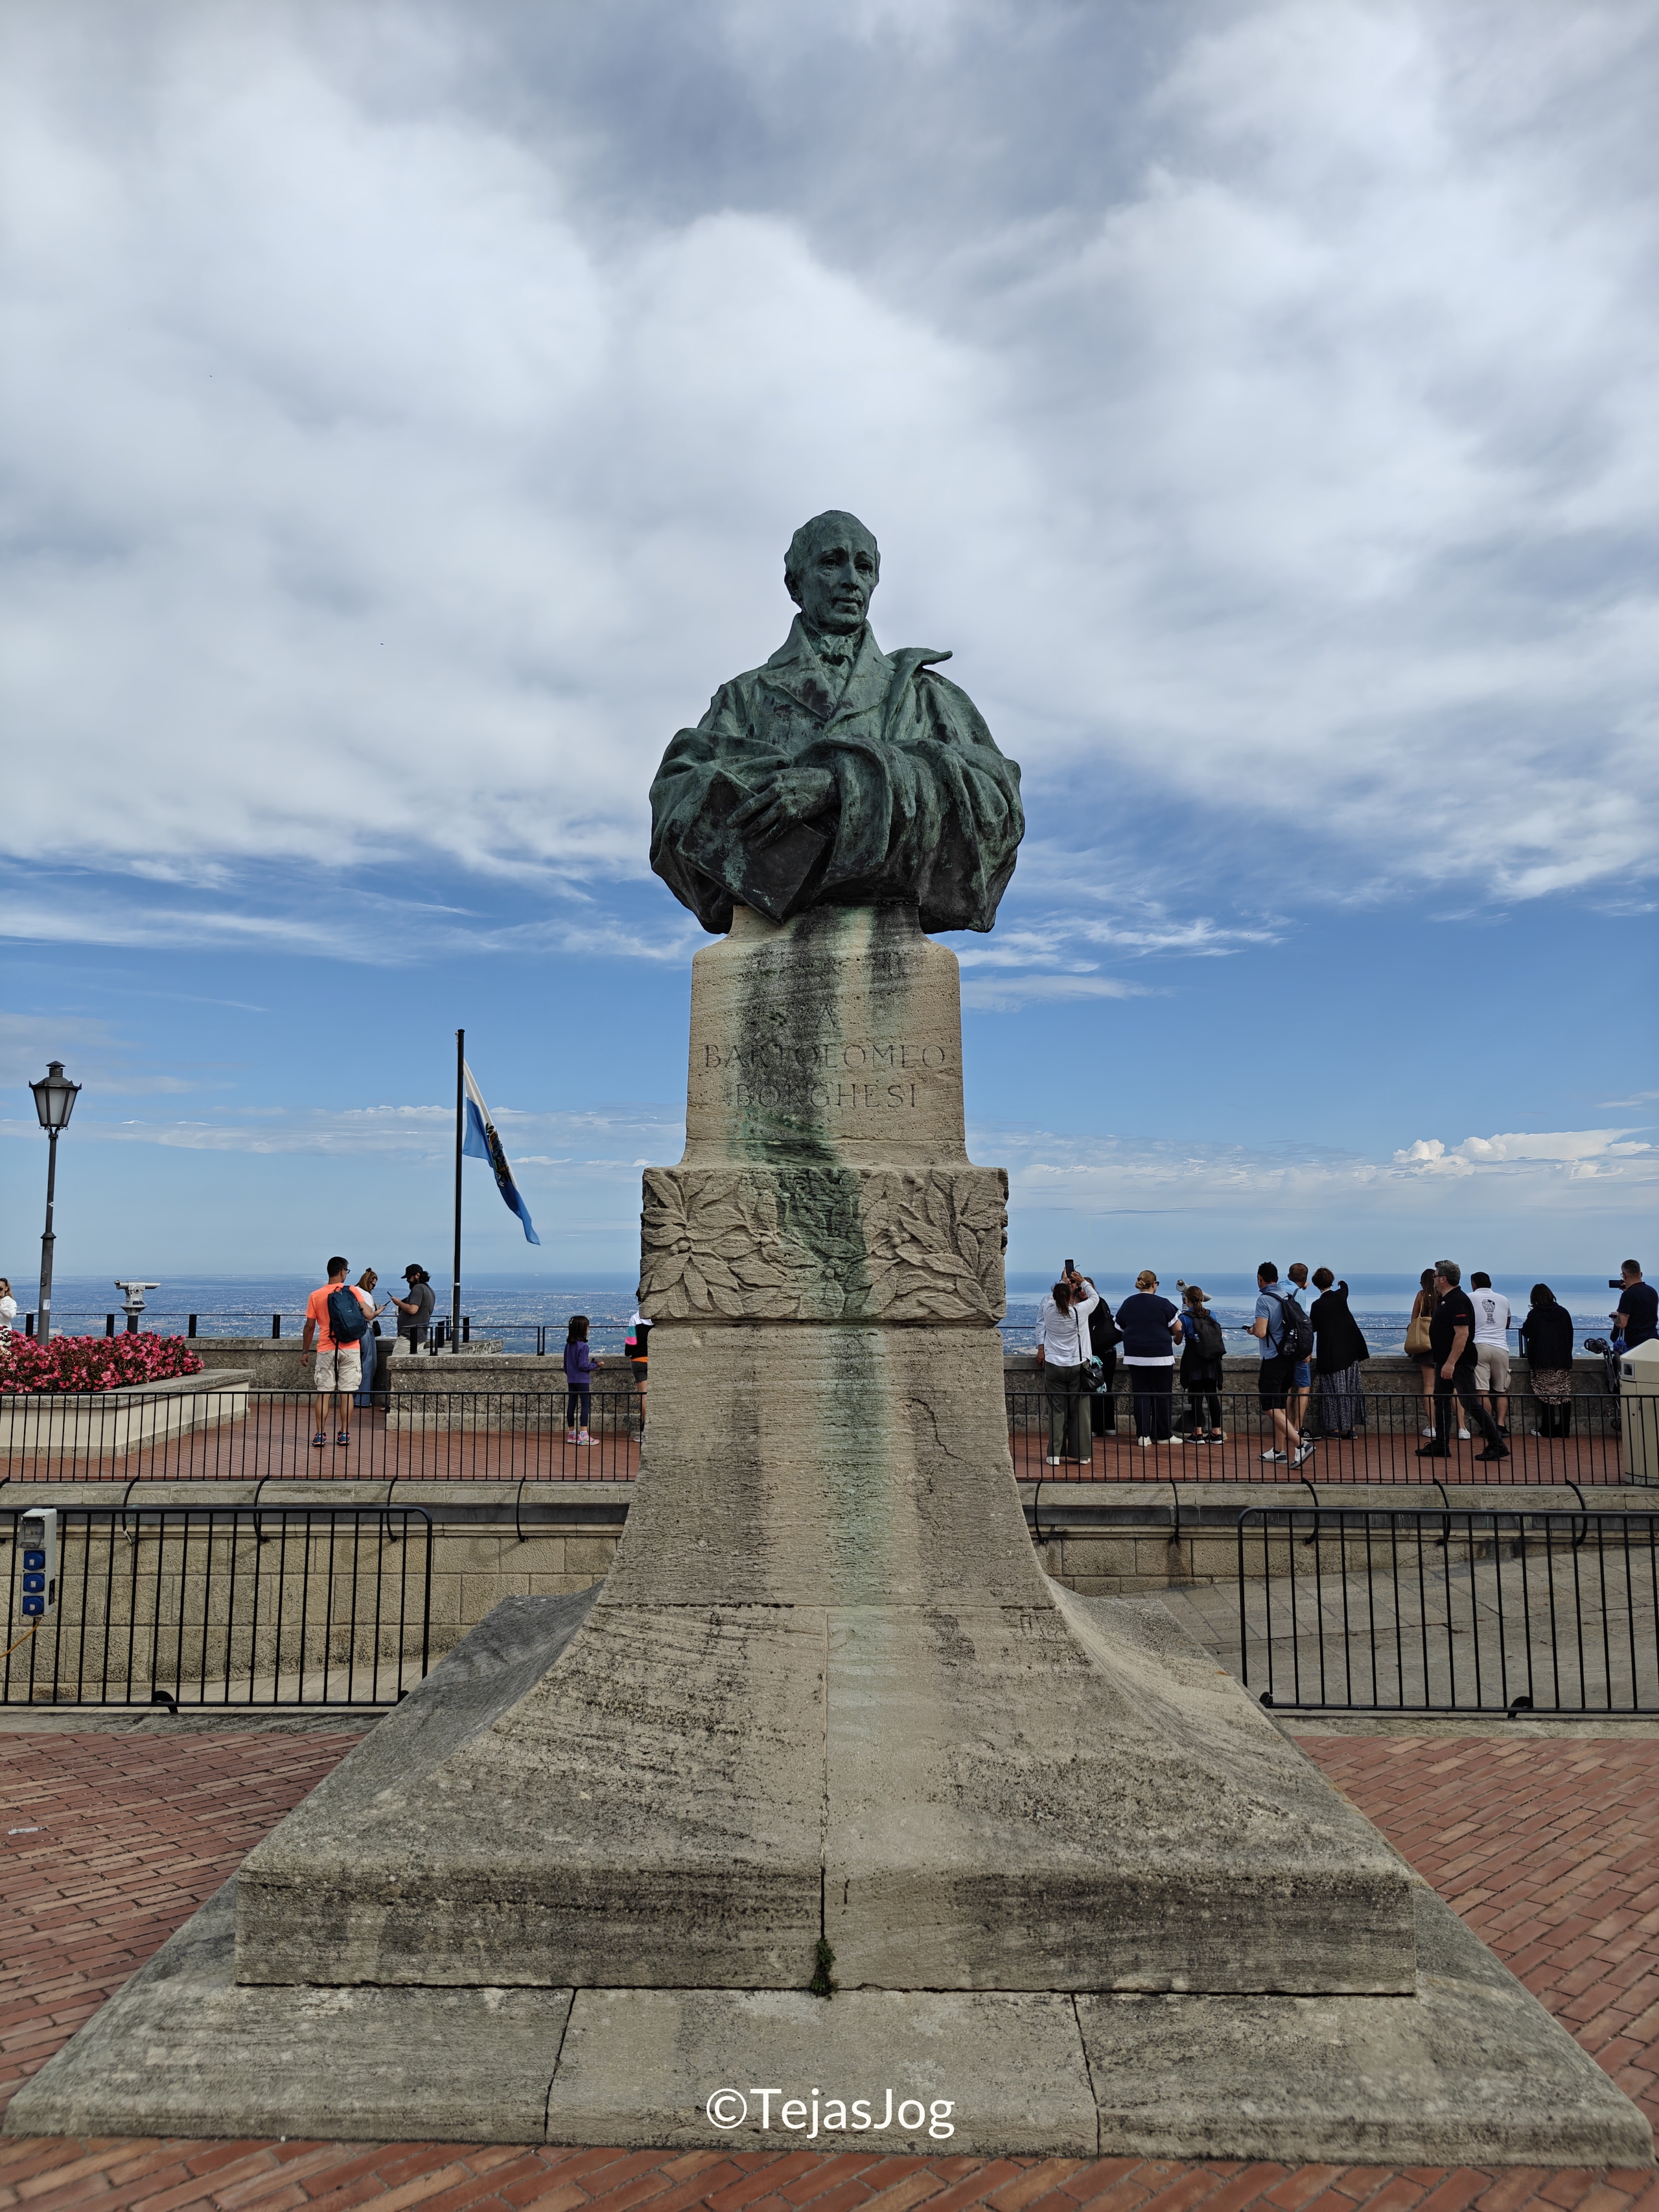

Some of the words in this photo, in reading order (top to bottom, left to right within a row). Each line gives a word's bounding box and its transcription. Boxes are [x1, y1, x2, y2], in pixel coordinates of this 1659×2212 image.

[816, 1004, 838, 1028] A
[704, 1044, 947, 1069] BARTOLOMEO
[736, 1084, 916, 1108] BORGHESI
